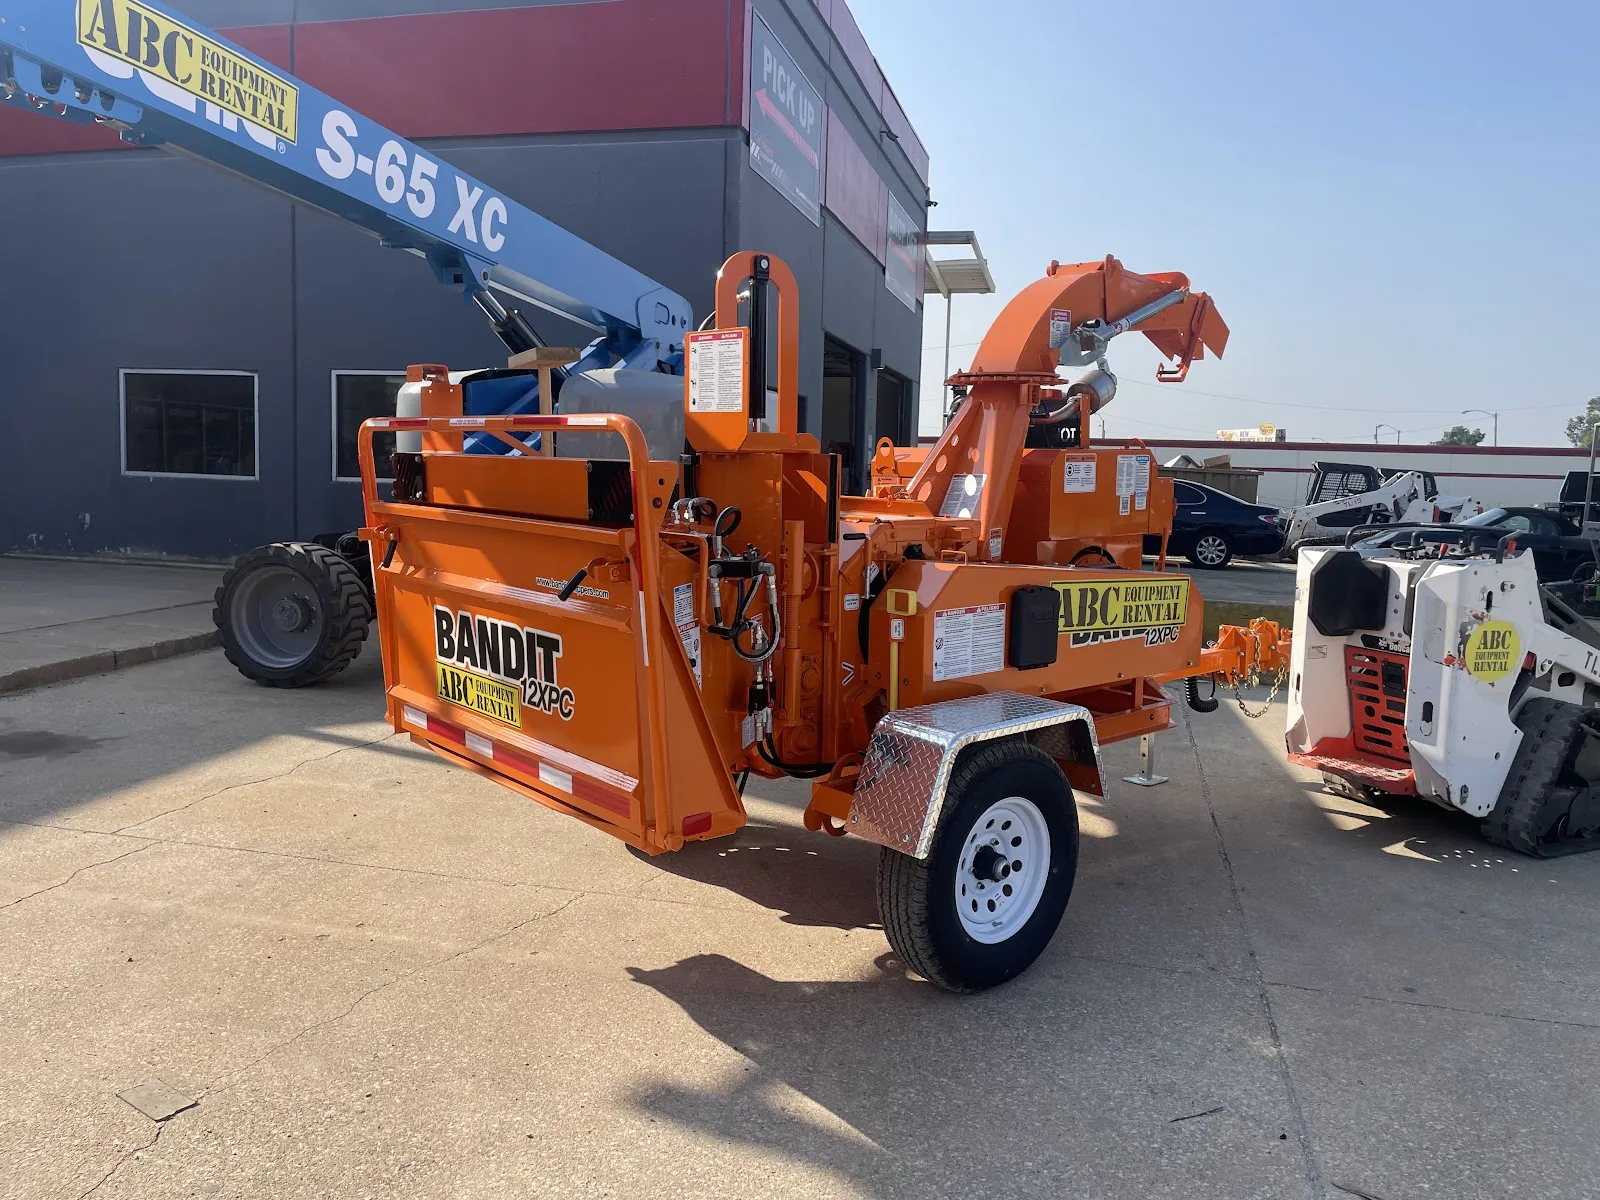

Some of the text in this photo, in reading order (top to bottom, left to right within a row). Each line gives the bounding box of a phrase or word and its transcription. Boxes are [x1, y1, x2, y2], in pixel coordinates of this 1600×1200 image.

[85, 0, 194, 84] ABC
[201, 45, 288, 106] EQUIPMENT
[763, 44, 815, 135] PICK UP
[200, 68, 288, 133] RENTAL
[315, 109, 508, 252] S-65 XC
[1057, 427, 1077, 442] OT
[1059, 586, 1120, 628] ABC
[1124, 585, 1181, 602] EQUIPMENT
[1122, 603, 1181, 623] RENTAL
[434, 607, 562, 685] BANDIT
[1144, 626, 1179, 646] 12XPC
[1389, 642, 1410, 654] Bobca
[1477, 630, 1512, 650] ABC
[1473, 661, 1508, 671] RENTAL
[1475, 651, 1510, 661] EQUIPMENT
[440, 668, 474, 706] ABC
[476, 680, 515, 704] EQUIPMENT
[520, 677, 575, 719] 12XPC
[476, 694, 517, 722] RENTAL
